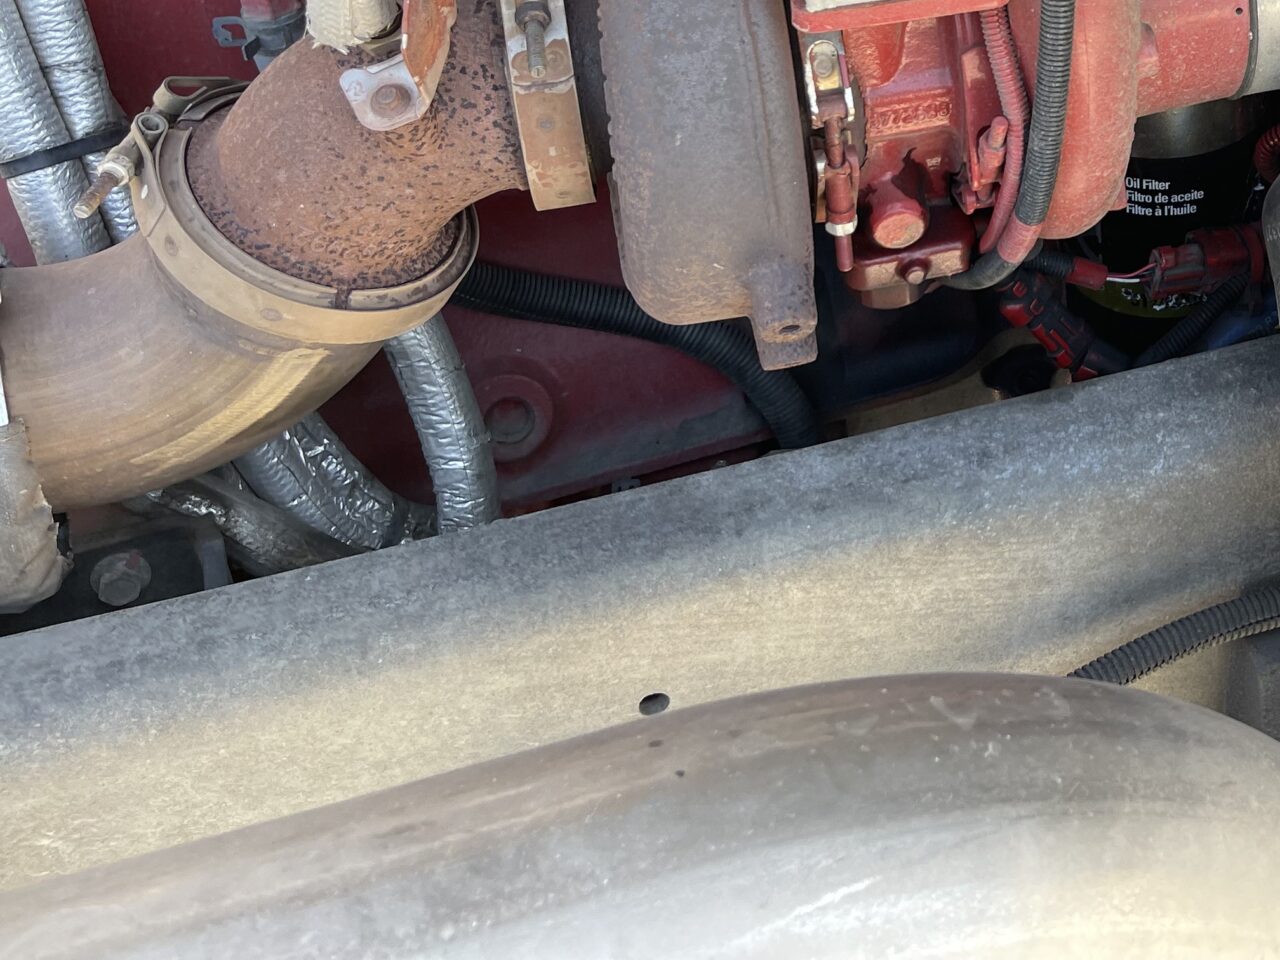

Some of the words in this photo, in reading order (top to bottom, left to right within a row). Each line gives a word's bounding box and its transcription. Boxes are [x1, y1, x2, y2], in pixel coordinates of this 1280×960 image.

[1125, 176, 1140, 189] Oil
[1142, 178, 1170, 190] Filter
[1126, 190, 1152, 203] Filtro
[1154, 193, 1169, 203] de
[1171, 189, 1204, 203] aceite
[1126, 203, 1152, 216] Filtre
[1155, 205, 1162, 216] à
